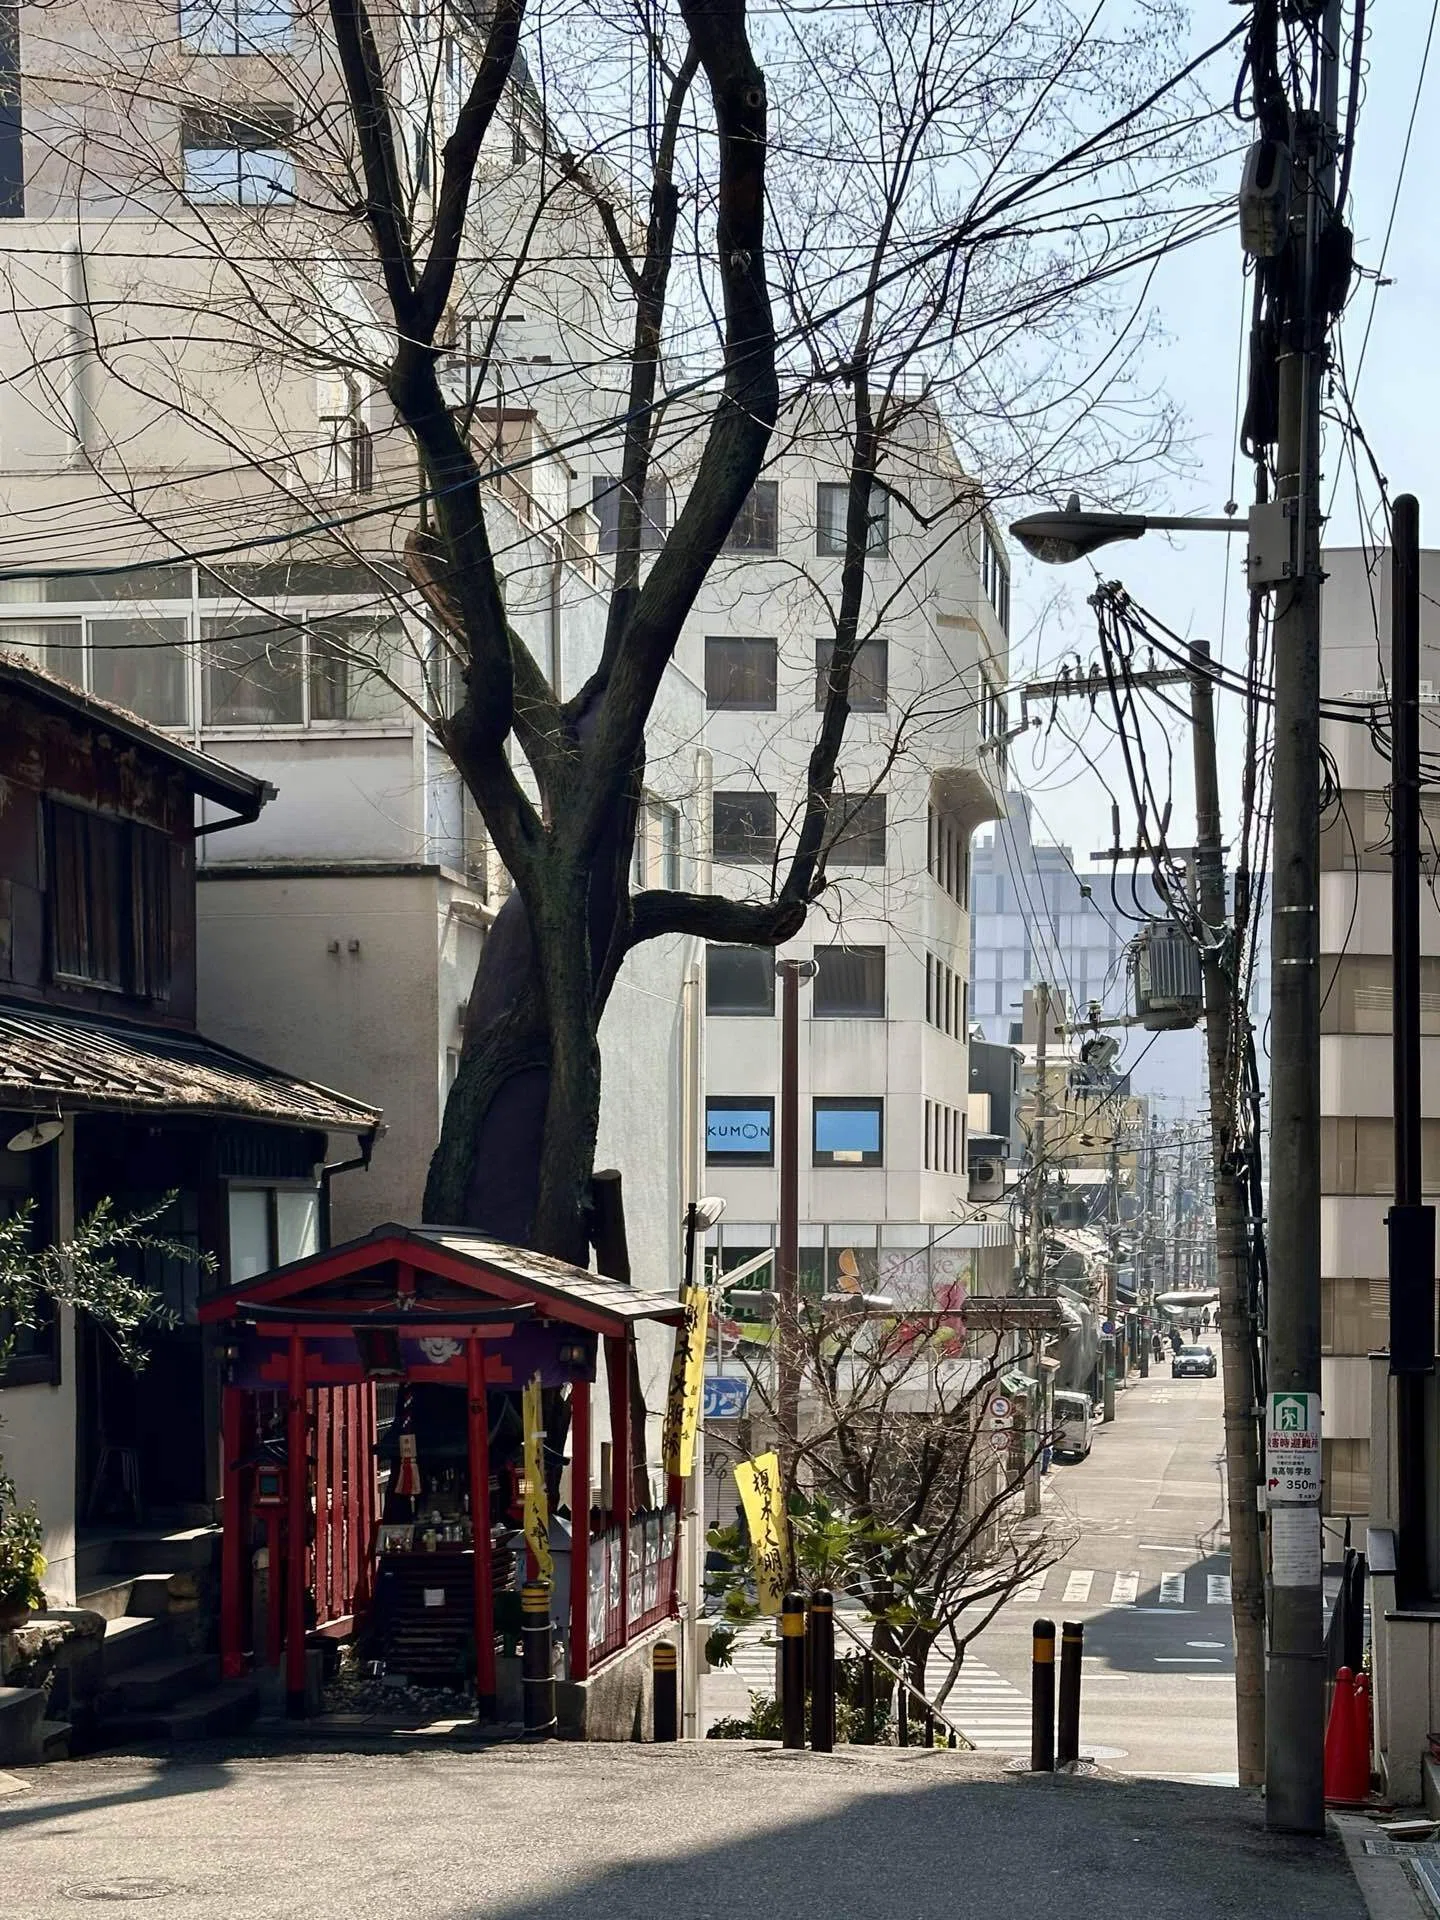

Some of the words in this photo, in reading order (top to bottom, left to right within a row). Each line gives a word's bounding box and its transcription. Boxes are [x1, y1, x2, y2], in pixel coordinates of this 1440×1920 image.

[708, 1123, 770, 1139] KUMON
[888, 1252, 954, 1273] Shake
[1286, 1480, 1317, 1490] 350m
